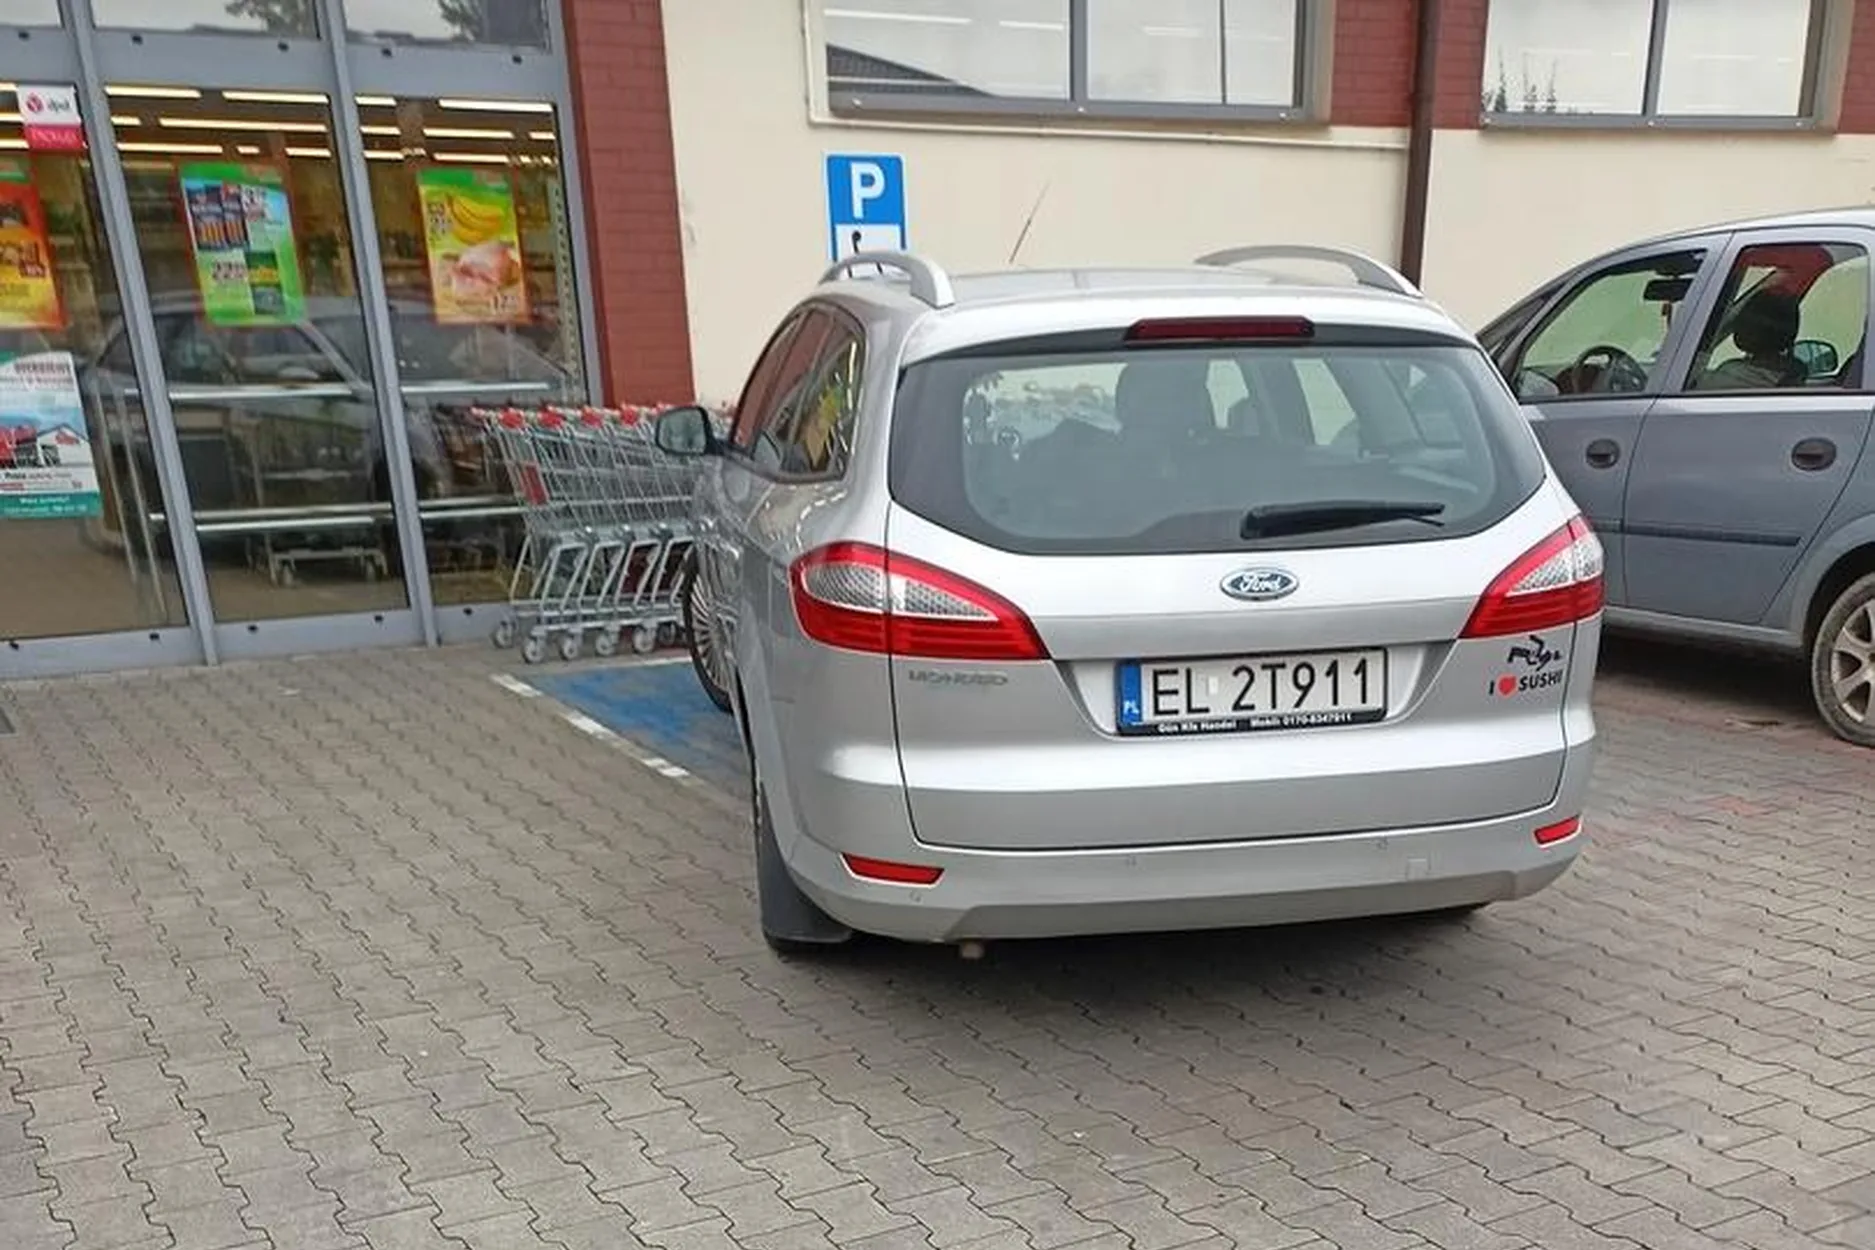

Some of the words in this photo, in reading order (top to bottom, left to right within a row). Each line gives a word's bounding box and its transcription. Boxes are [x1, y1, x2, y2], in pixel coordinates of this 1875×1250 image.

[851, 161, 885, 219] P
[1240, 571, 1281, 592] Ford
[1153, 667, 1210, 716] EL
[1231, 657, 1368, 712] 2T911
[1489, 680, 1495, 695] I
[1519, 669, 1563, 691] SUSHI
[1123, 700, 1140, 715] PL
